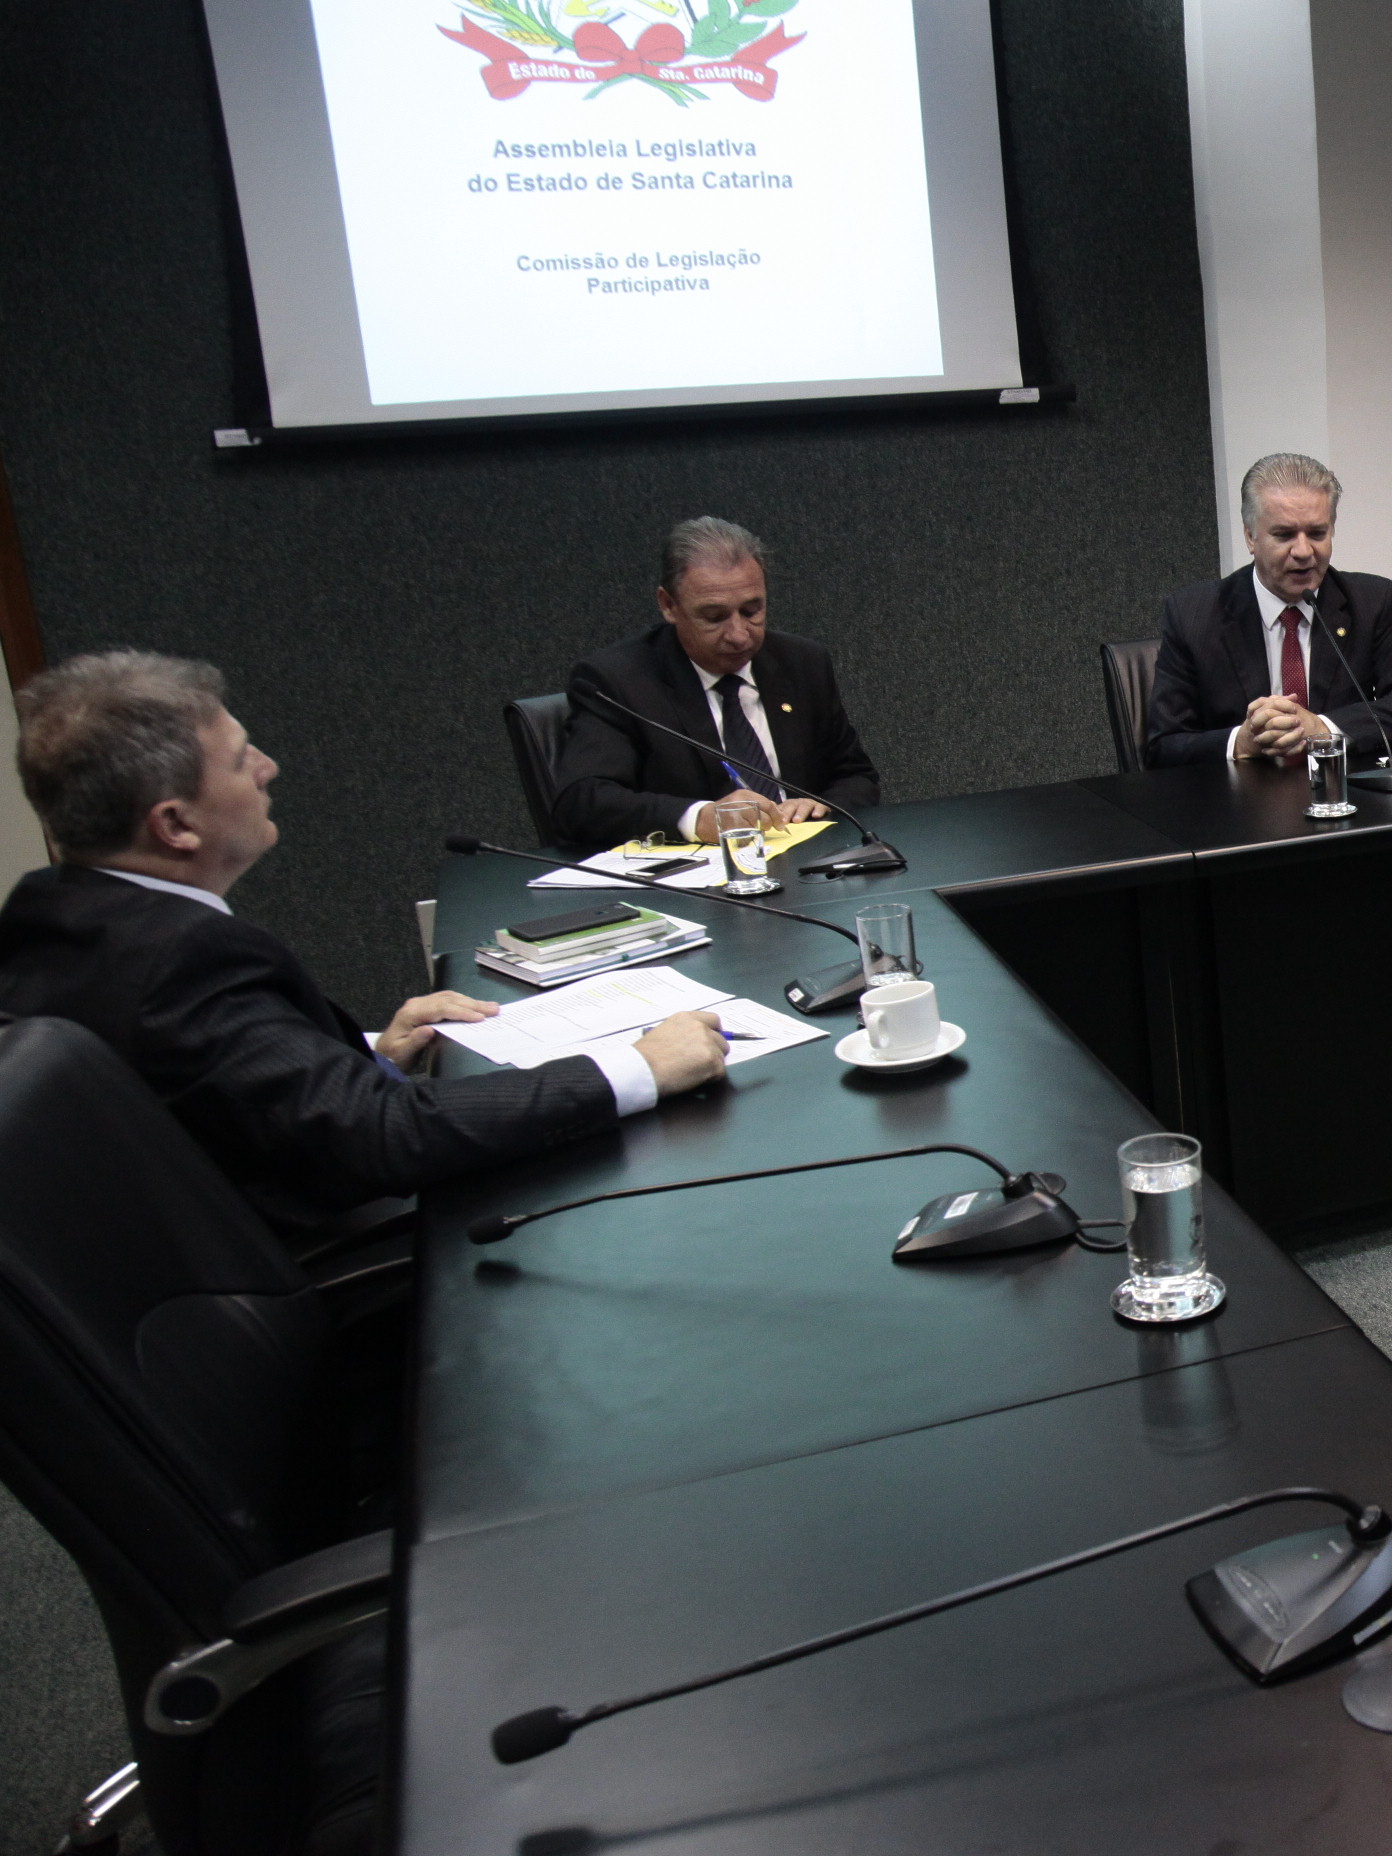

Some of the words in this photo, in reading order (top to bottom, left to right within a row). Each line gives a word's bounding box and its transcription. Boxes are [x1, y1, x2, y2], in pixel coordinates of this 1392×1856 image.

[508, 61, 571, 80] Estado
[658, 67, 690, 80] Sta.
[693, 65, 765, 85] Catarina
[493, 139, 628, 159] Assembleia
[635, 138, 757, 162] Legislativa
[467, 173, 499, 193] do
[506, 172, 588, 192] Estado
[596, 171, 624, 191] de
[631, 171, 695, 191] Santa
[702, 170, 793, 190] Catarina
[516, 251, 619, 272] Comissão
[625, 252, 650, 269] de
[655, 248, 761, 271] Legislação
[587, 274, 710, 296] Participativa
